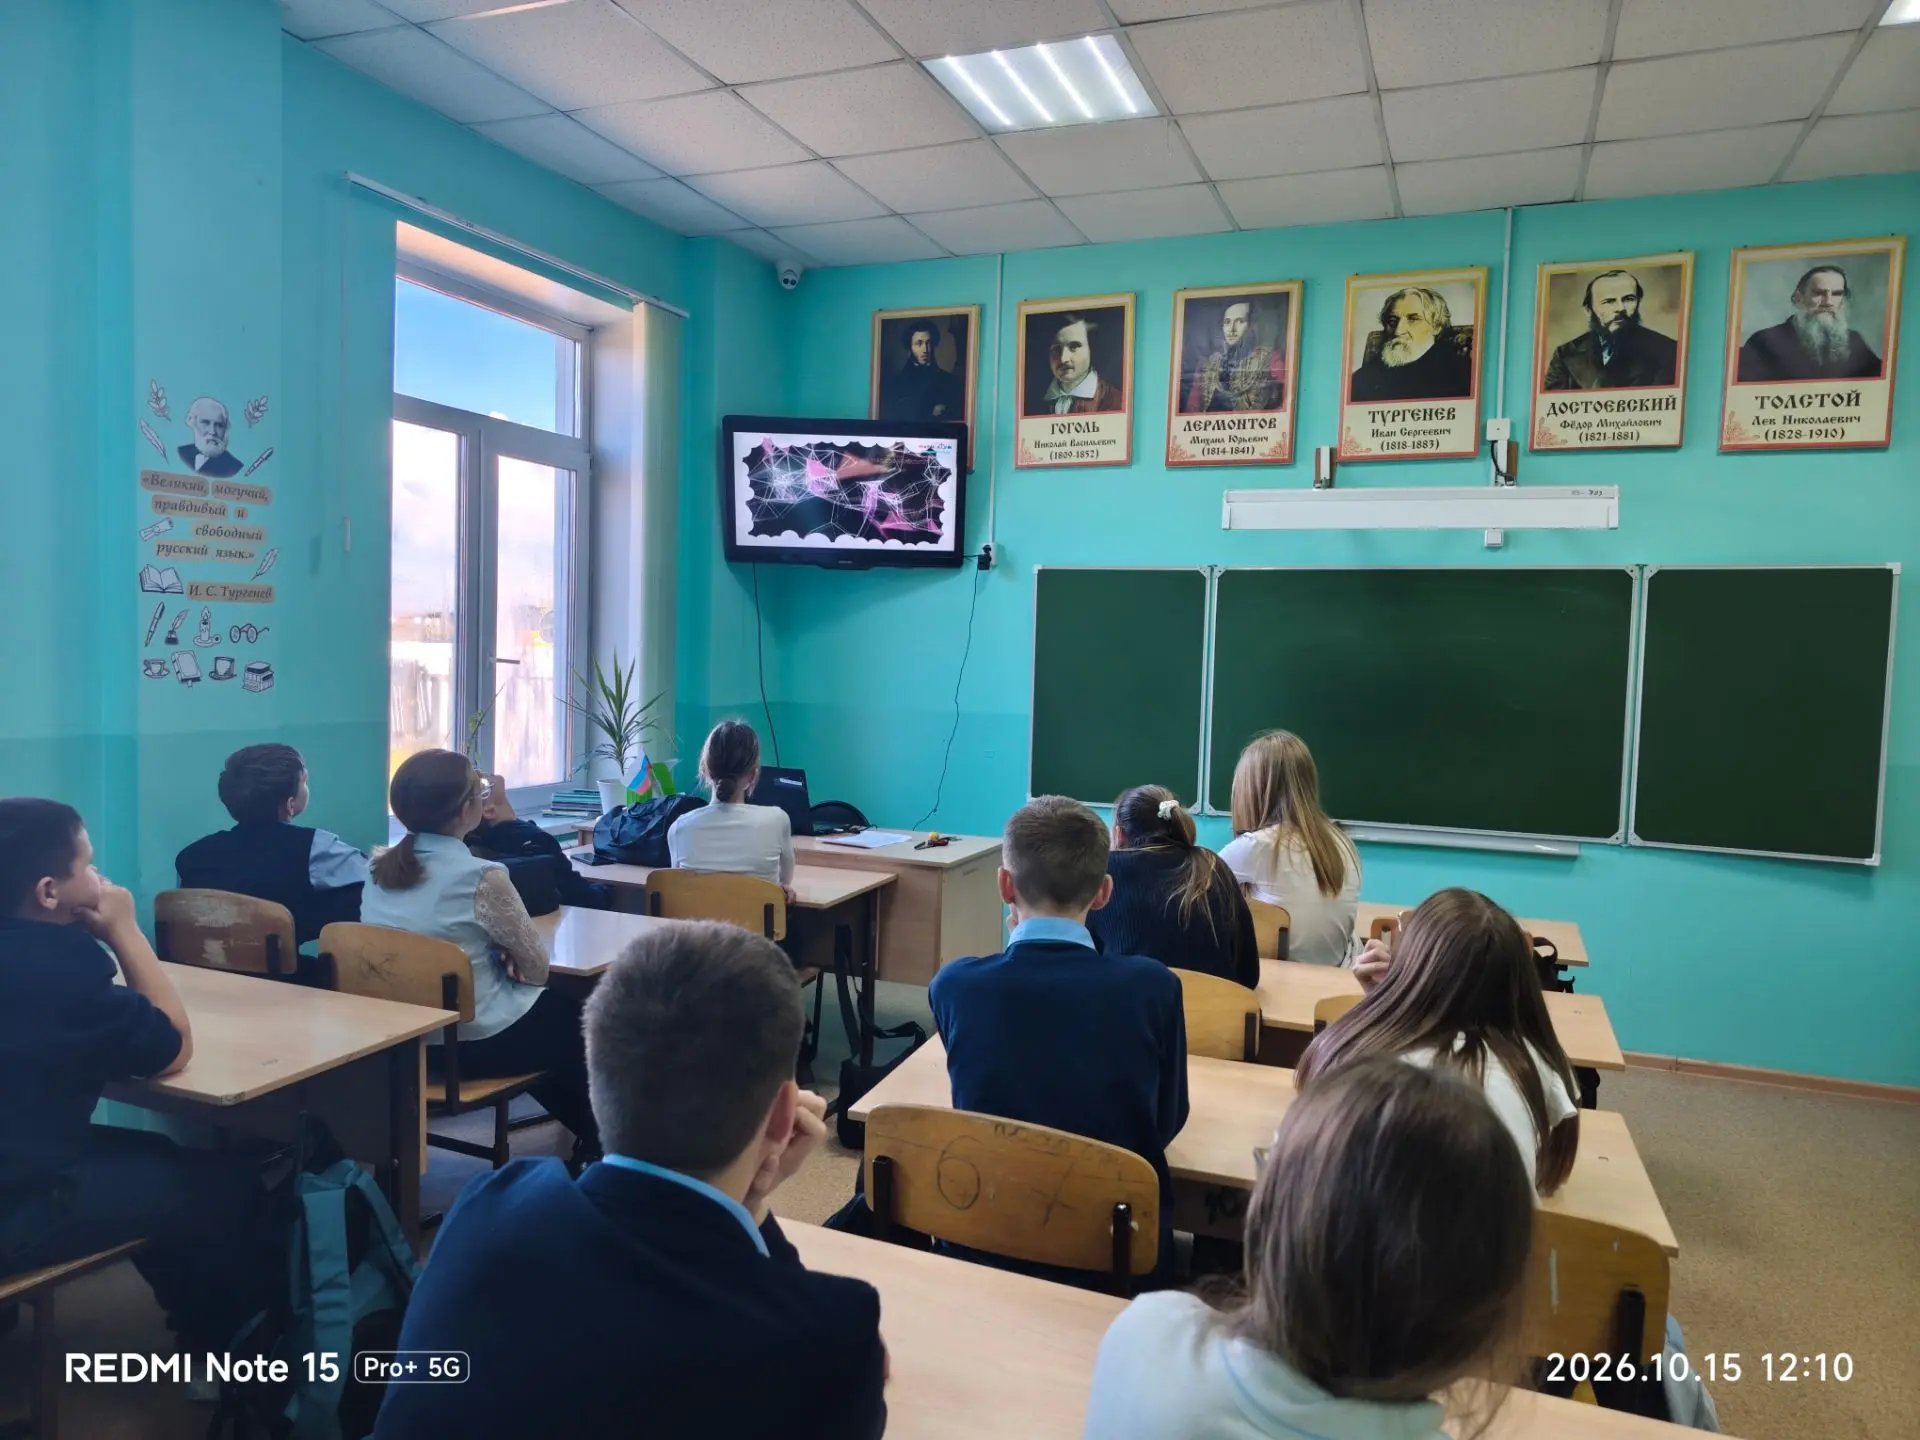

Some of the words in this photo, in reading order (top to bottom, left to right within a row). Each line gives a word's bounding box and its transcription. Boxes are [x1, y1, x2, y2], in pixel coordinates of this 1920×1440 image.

[1546, 394, 1677, 417] ДОСТОЕВСКИЙ
[1755, 389, 1862, 410] ТОЛСТОЙ
[1368, 407, 1456, 426] ТУРГЕНЕВ
[1751, 416, 1777, 426] Лев
[1782, 415, 1861, 425] Николаевич
[1050, 421, 1100, 435] ГОГОЛЬ
[1183, 417, 1277, 432] ЛЕРМОНТОВ
[1559, 419, 1593, 431] Фёдор
[1596, 418, 1662, 430] Михайлович
[1371, 429, 1397, 438] Иван
[1400, 427, 1451, 438] Сергеевич
[1578, 430, 1640, 443] (1821-1881)
[1764, 427, 1846, 441] (1828-1910)
[1034, 439, 1067, 449] Николай
[1070, 438, 1116, 448] Васильевич
[1190, 435, 1225, 446] Михаил
[1228, 434, 1269, 445] Юрьевич
[1380, 438, 1440, 452] (1818-1883)
[1049, 449, 1099, 461] (1809-1852)
[1201, 445, 1255, 457] (1814-1841)
[142, 473, 207, 494] «Великий,
[153, 500, 226, 516] правдивый
[237, 508, 245, 518] и
[195, 524, 263, 541] свободный
[156, 542, 208, 557] русский
[188, 584, 202, 596] И.
[220, 585, 273, 601] Тургенев
